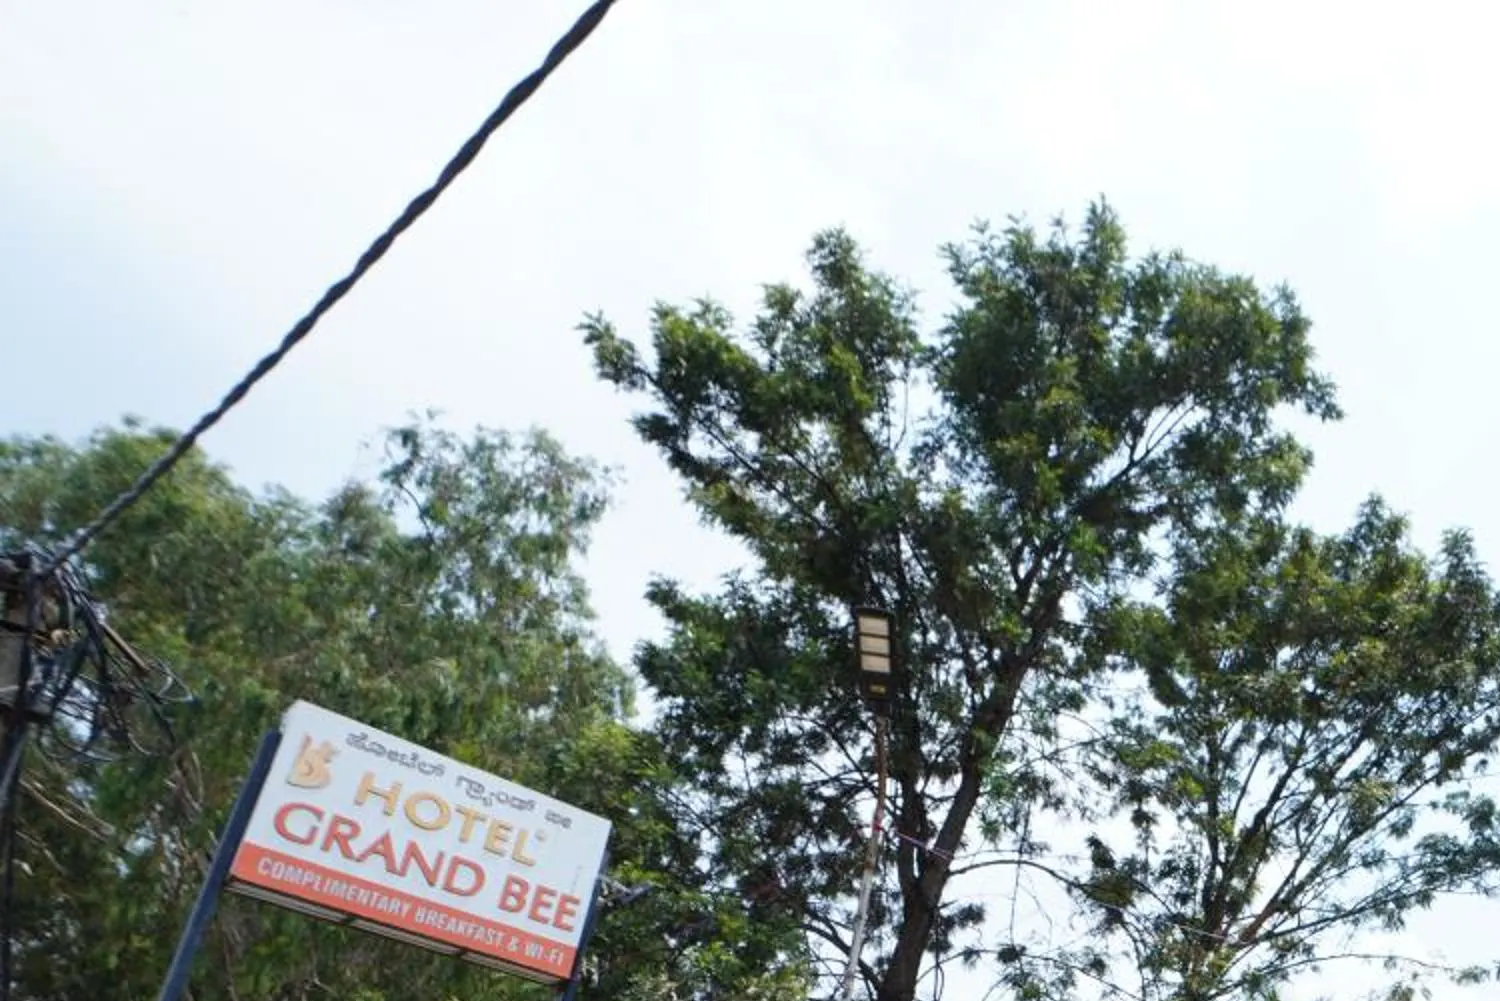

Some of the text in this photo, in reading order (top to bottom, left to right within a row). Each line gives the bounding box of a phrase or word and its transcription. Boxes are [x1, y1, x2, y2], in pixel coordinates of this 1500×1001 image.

[353, 770, 537, 867] HOTEL
[257, 856, 411, 919] COMPLIMENTARY
[414, 902, 504, 946] BREAKFAST
[507, 936, 518, 952] &
[273, 802, 581, 933] GRAND BEE
